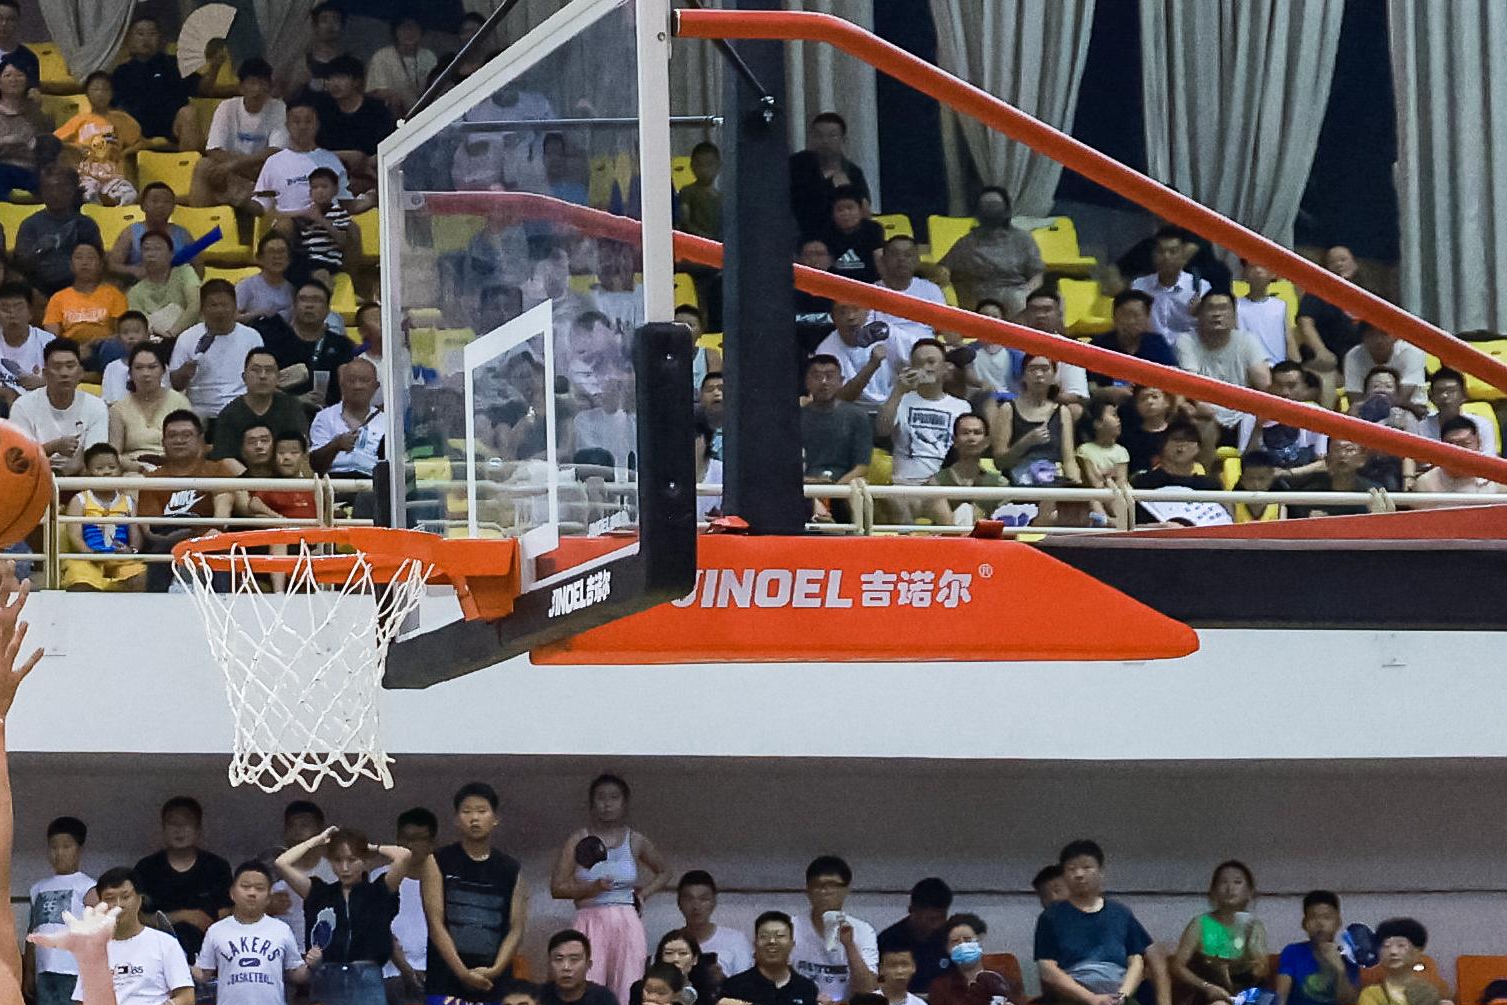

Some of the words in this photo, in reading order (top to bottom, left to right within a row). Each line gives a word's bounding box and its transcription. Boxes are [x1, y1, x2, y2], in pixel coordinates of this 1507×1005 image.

[548, 578, 588, 618] JINOEL
[860, 569, 973, 609] 吉诺尔
[221, 936, 282, 963] LAKERS
